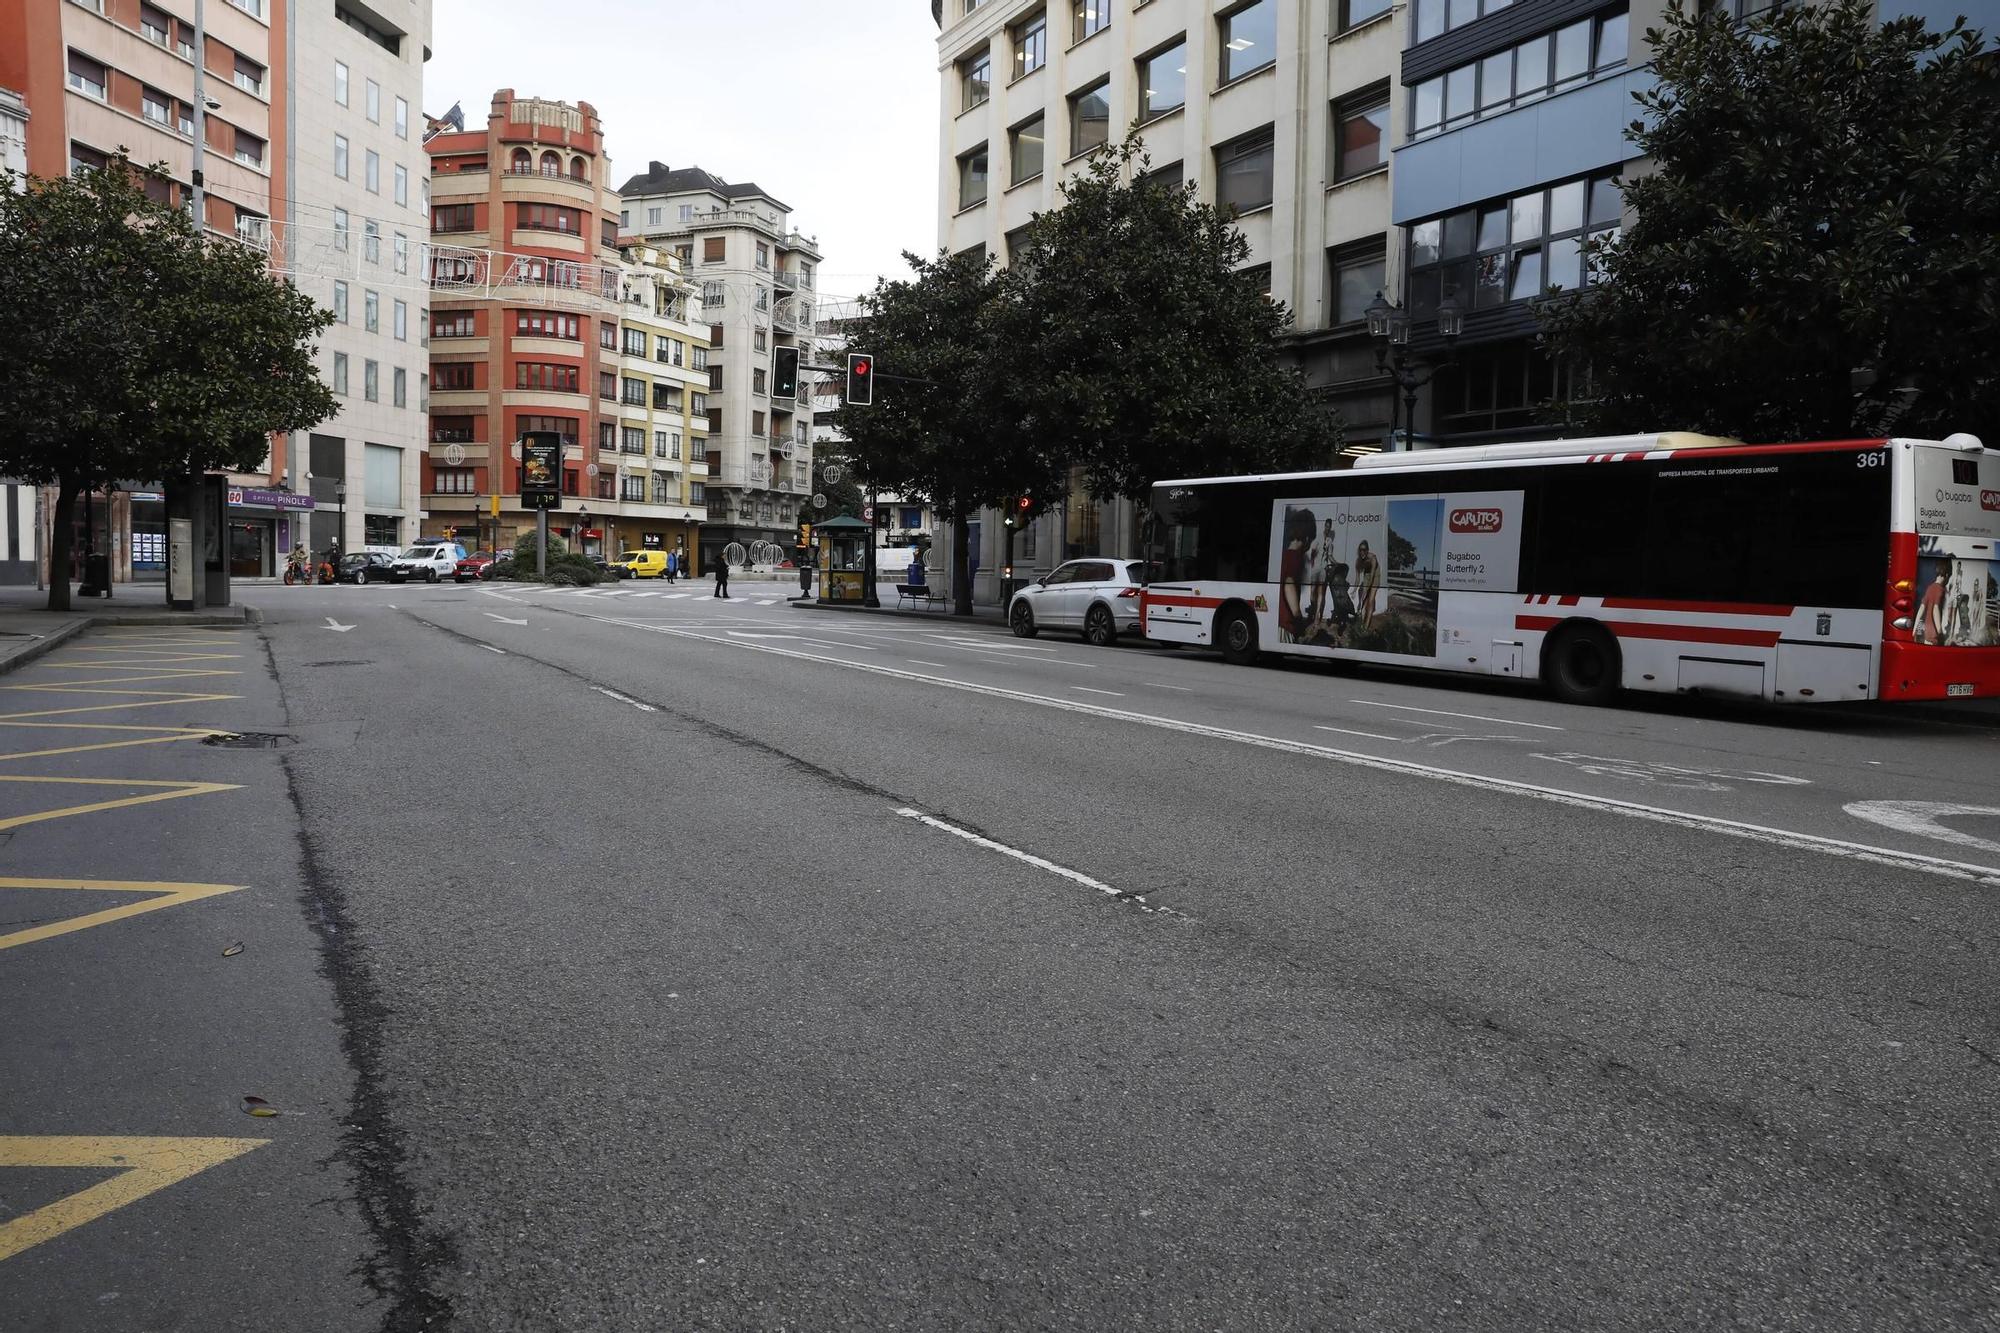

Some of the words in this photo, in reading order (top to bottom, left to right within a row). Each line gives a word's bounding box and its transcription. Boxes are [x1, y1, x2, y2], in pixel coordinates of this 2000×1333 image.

[1857, 451, 1887, 468] 361
[1681, 469, 1707, 477] MUNICIPAL
[1716, 467, 1753, 475] TRANSPORTES
[1752, 466, 1779, 474] URBANOS
[277, 496, 307, 506] PIÑOLE
[1920, 507, 1946, 519] Bugaboo
[1452, 512, 1500, 526] CARLITOS
[1920, 520, 1945, 532] Butterfly
[1945, 521, 1950, 531] 2
[1447, 551, 1481, 562] Bugaboo
[1446, 564, 1478, 575] Butterfly
[1479, 564, 1485, 573] 2
